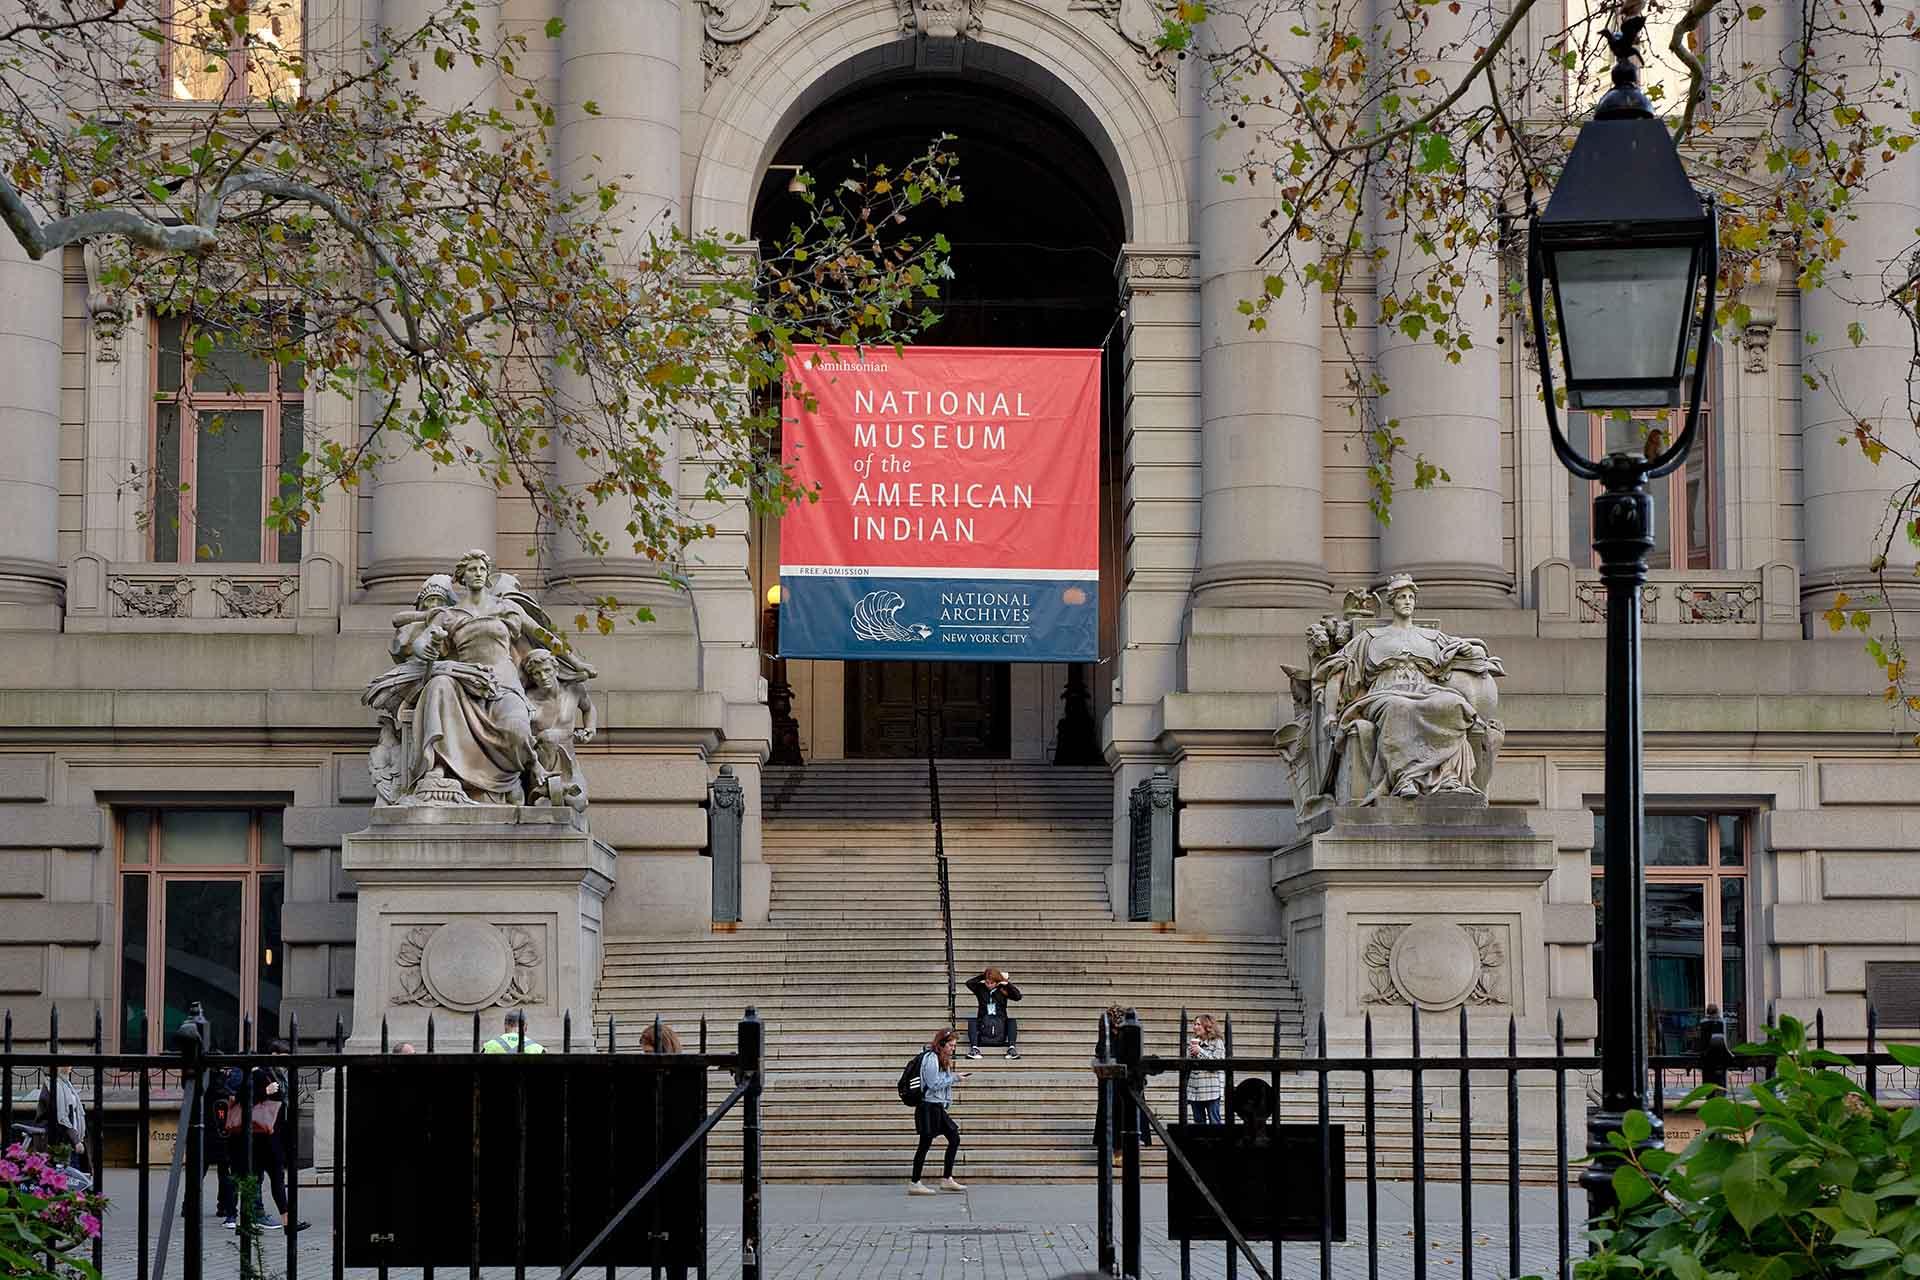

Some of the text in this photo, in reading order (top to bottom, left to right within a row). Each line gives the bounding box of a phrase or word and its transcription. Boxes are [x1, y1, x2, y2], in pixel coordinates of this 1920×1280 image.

[817, 359, 888, 372] Smithsonian
[854, 390, 1030, 417] NATIONAL
[853, 423, 1006, 450] MUSEUM
[853, 453, 912, 479] of the
[852, 482, 1033, 509] AMERICAN
[853, 516, 975, 542] INDIAN
[800, 567, 870, 576] FREE ADMISSION
[941, 592, 1030, 606] NATIONAL
[940, 607, 1030, 622] ARCHIVES
[942, 632, 1027, 644] NEW YORK CITY
